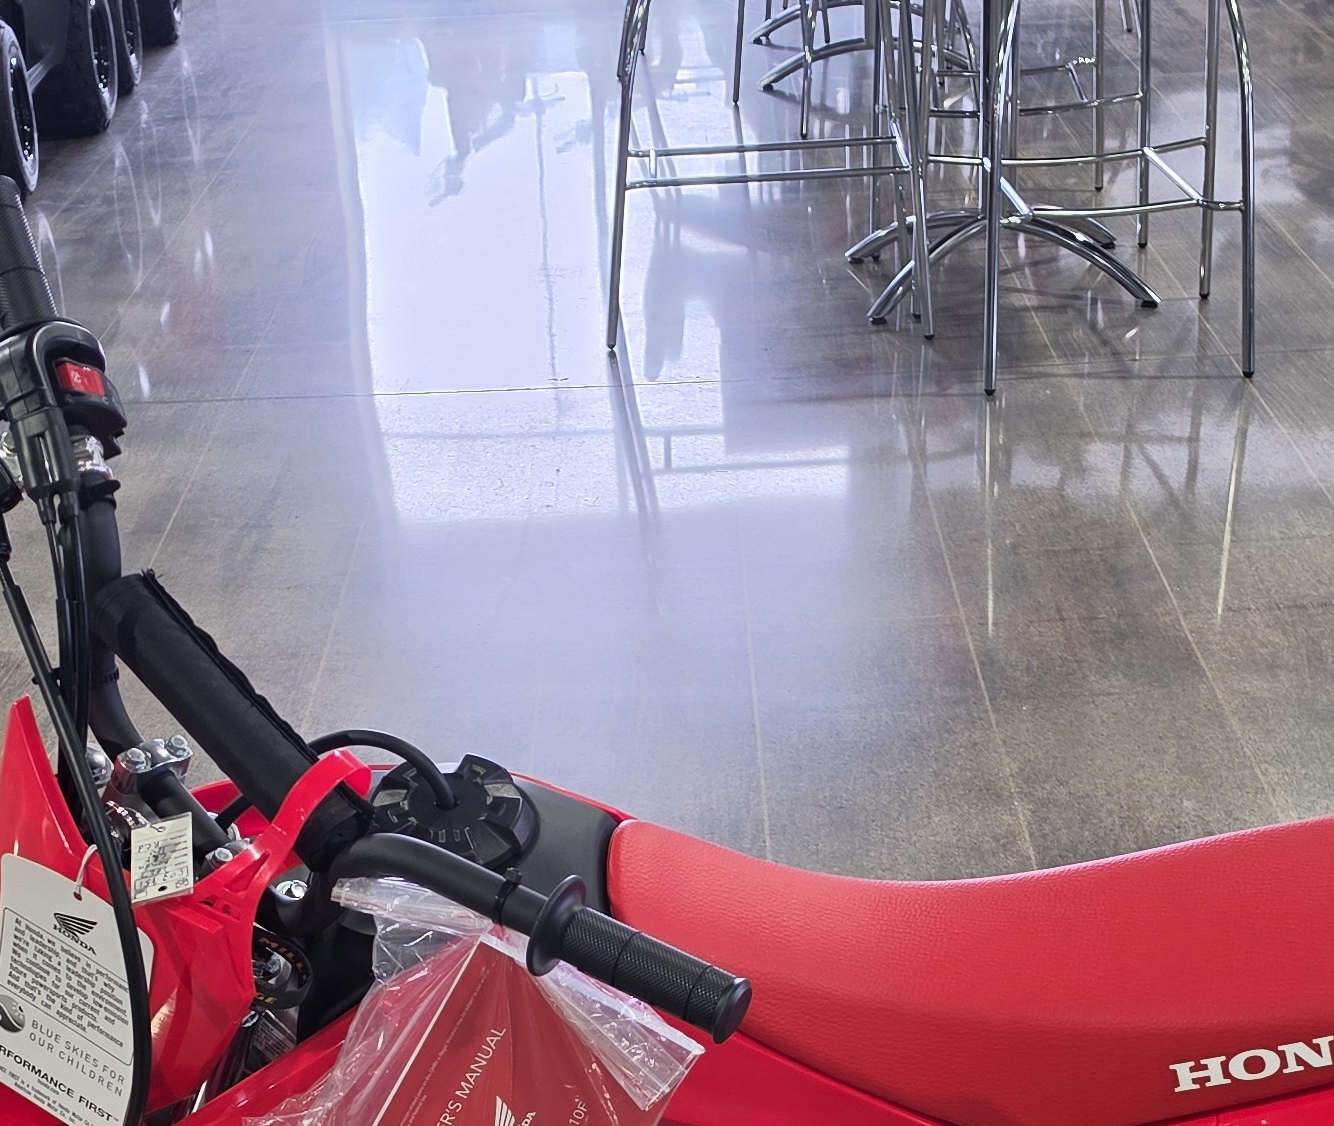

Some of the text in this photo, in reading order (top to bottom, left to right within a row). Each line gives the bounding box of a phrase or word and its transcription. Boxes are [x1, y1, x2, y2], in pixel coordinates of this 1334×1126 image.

[53, 924, 97, 955] HONDA
[95, 968, 130, 993] performanc
[29, 1032, 122, 1097] OUR CHILDREN
[31, 1019, 125, 1085] BLUE SKIES FOR
[455, 1028, 506, 1099] MANUAL
